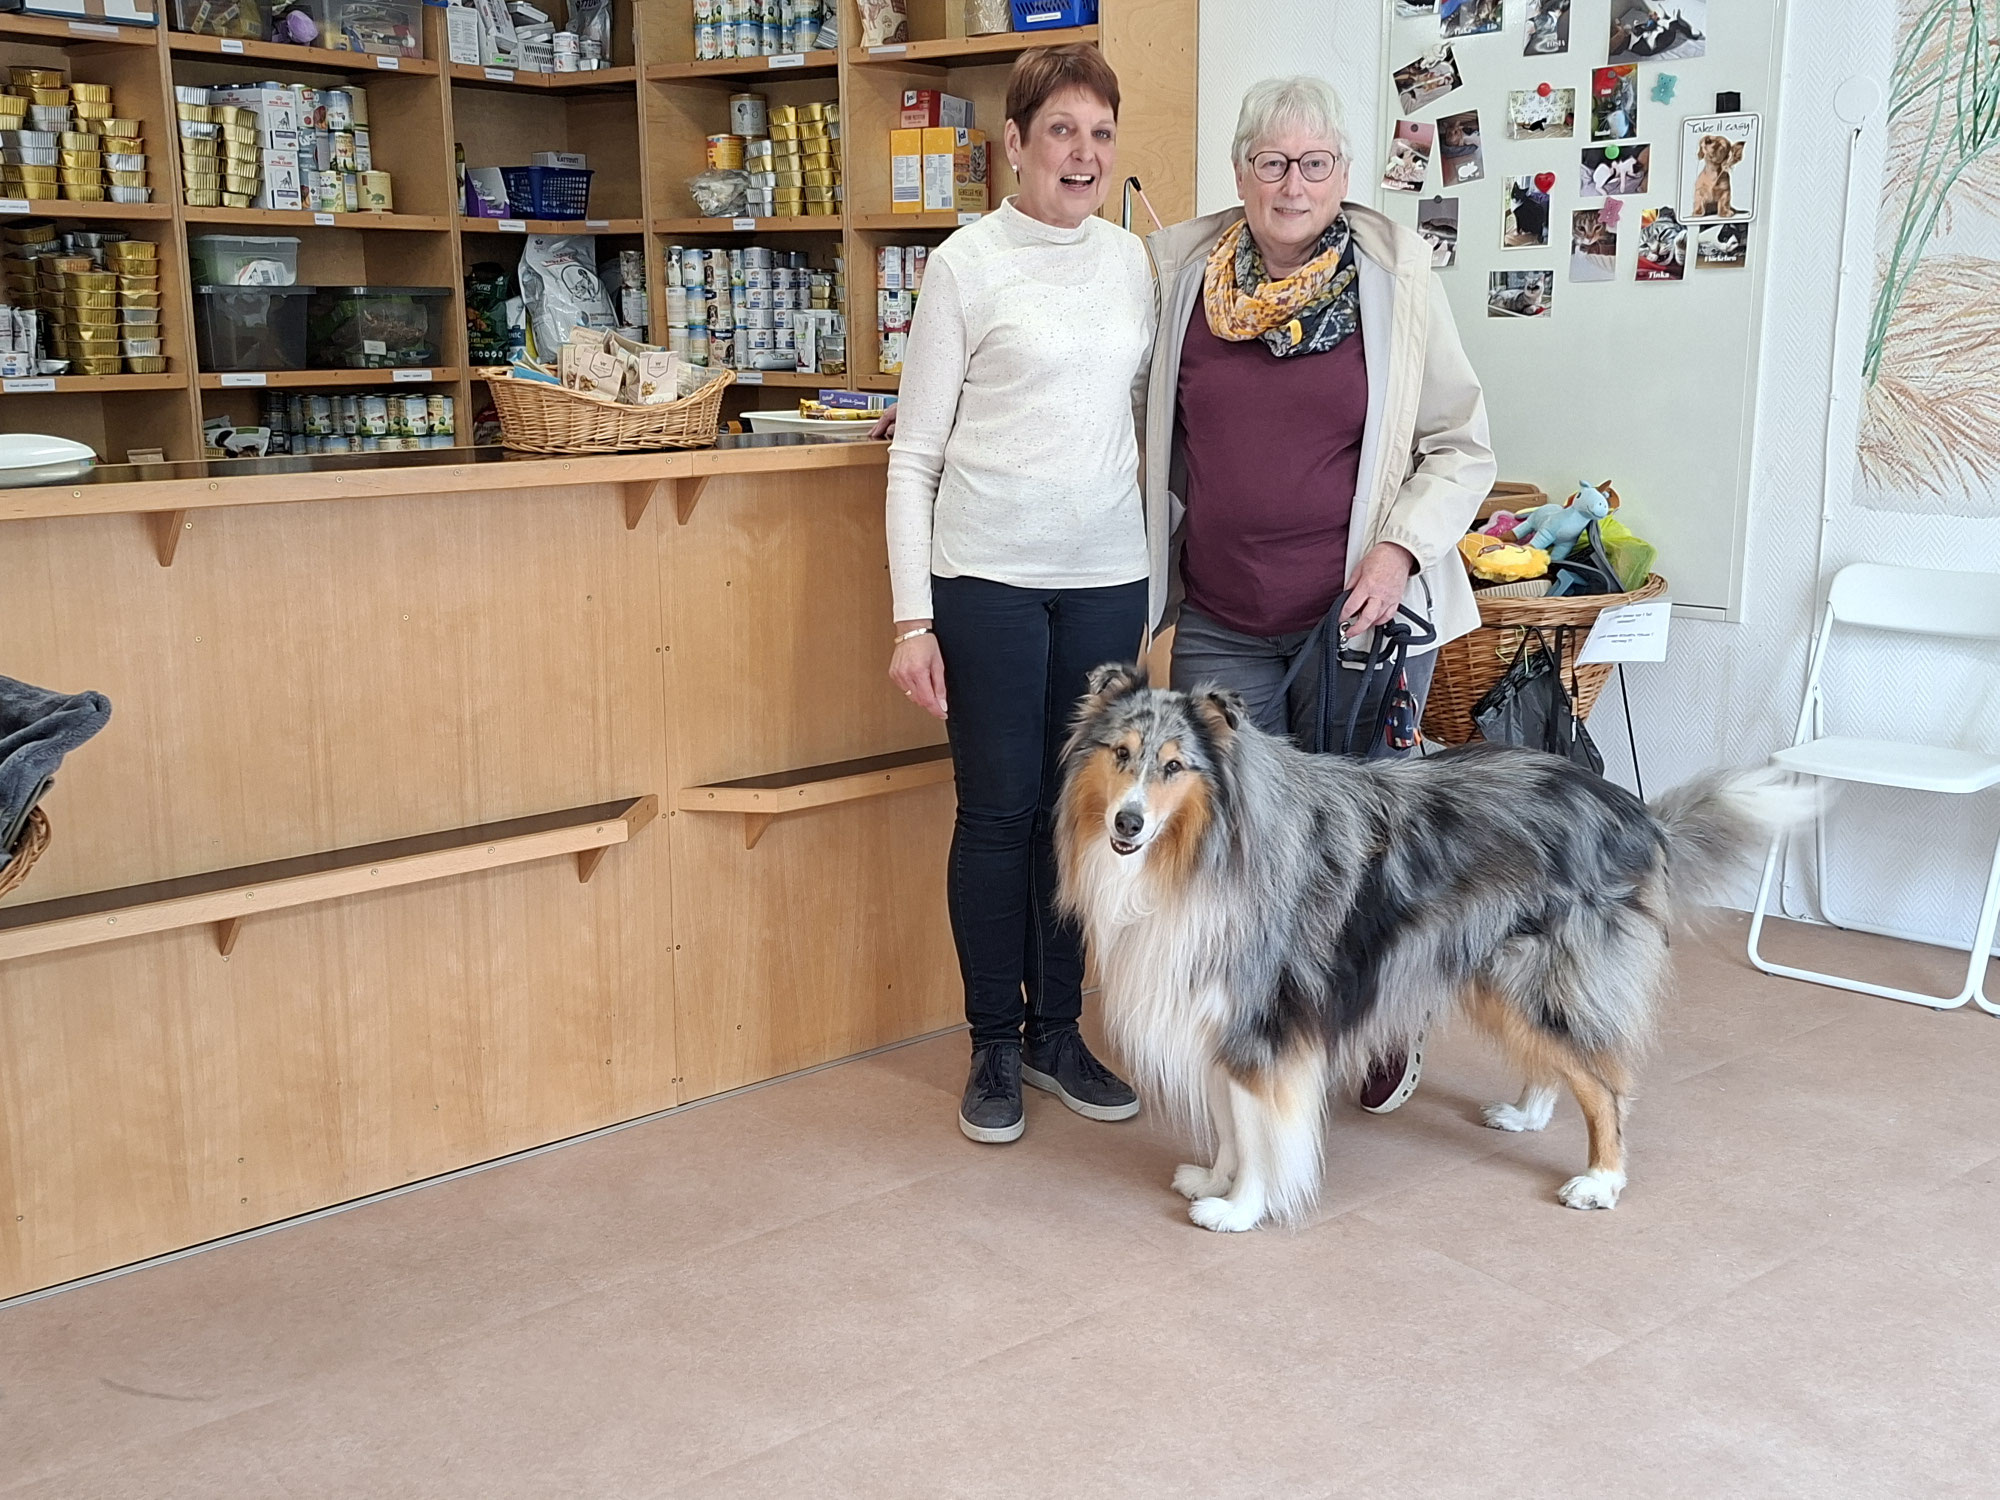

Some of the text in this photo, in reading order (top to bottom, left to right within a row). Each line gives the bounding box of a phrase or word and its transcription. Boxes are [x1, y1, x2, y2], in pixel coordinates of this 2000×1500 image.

[1687, 121, 1714, 133] Take
[1725, 118, 1756, 136] easy!
[1648, 270, 1670, 280] Tinka
